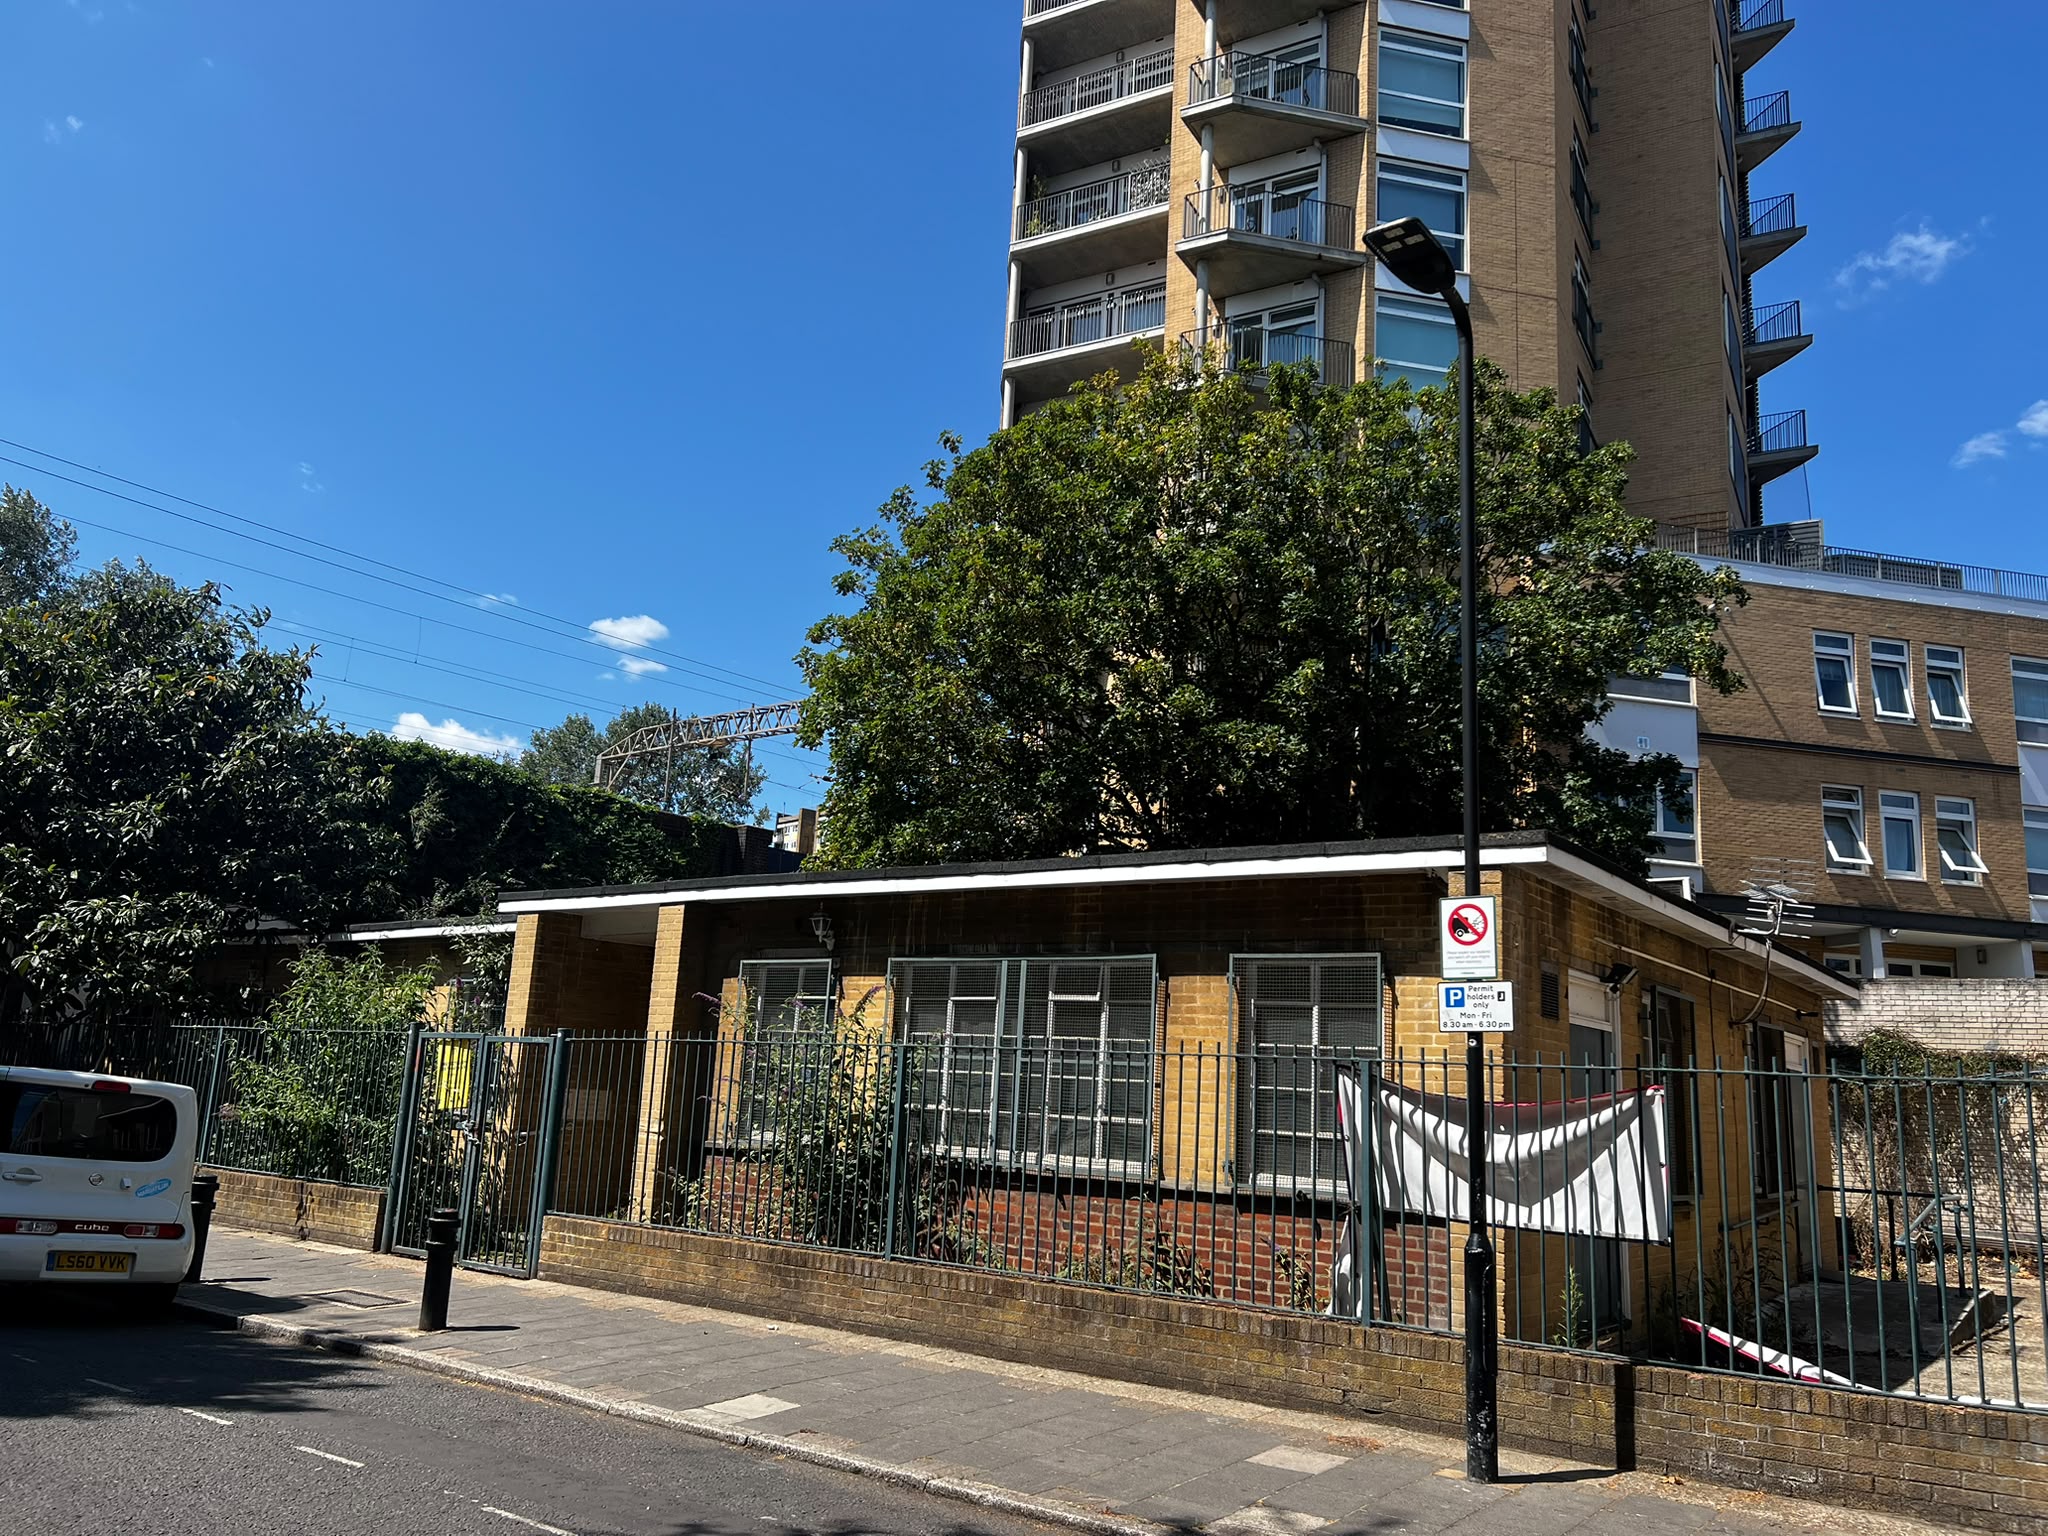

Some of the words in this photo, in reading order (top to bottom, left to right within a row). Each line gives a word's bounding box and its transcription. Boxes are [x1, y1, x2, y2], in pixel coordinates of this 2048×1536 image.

[1450, 990, 1462, 1006] P
[56, 1256, 95, 1268] LS60
[100, 1256, 126, 1270] VVK
